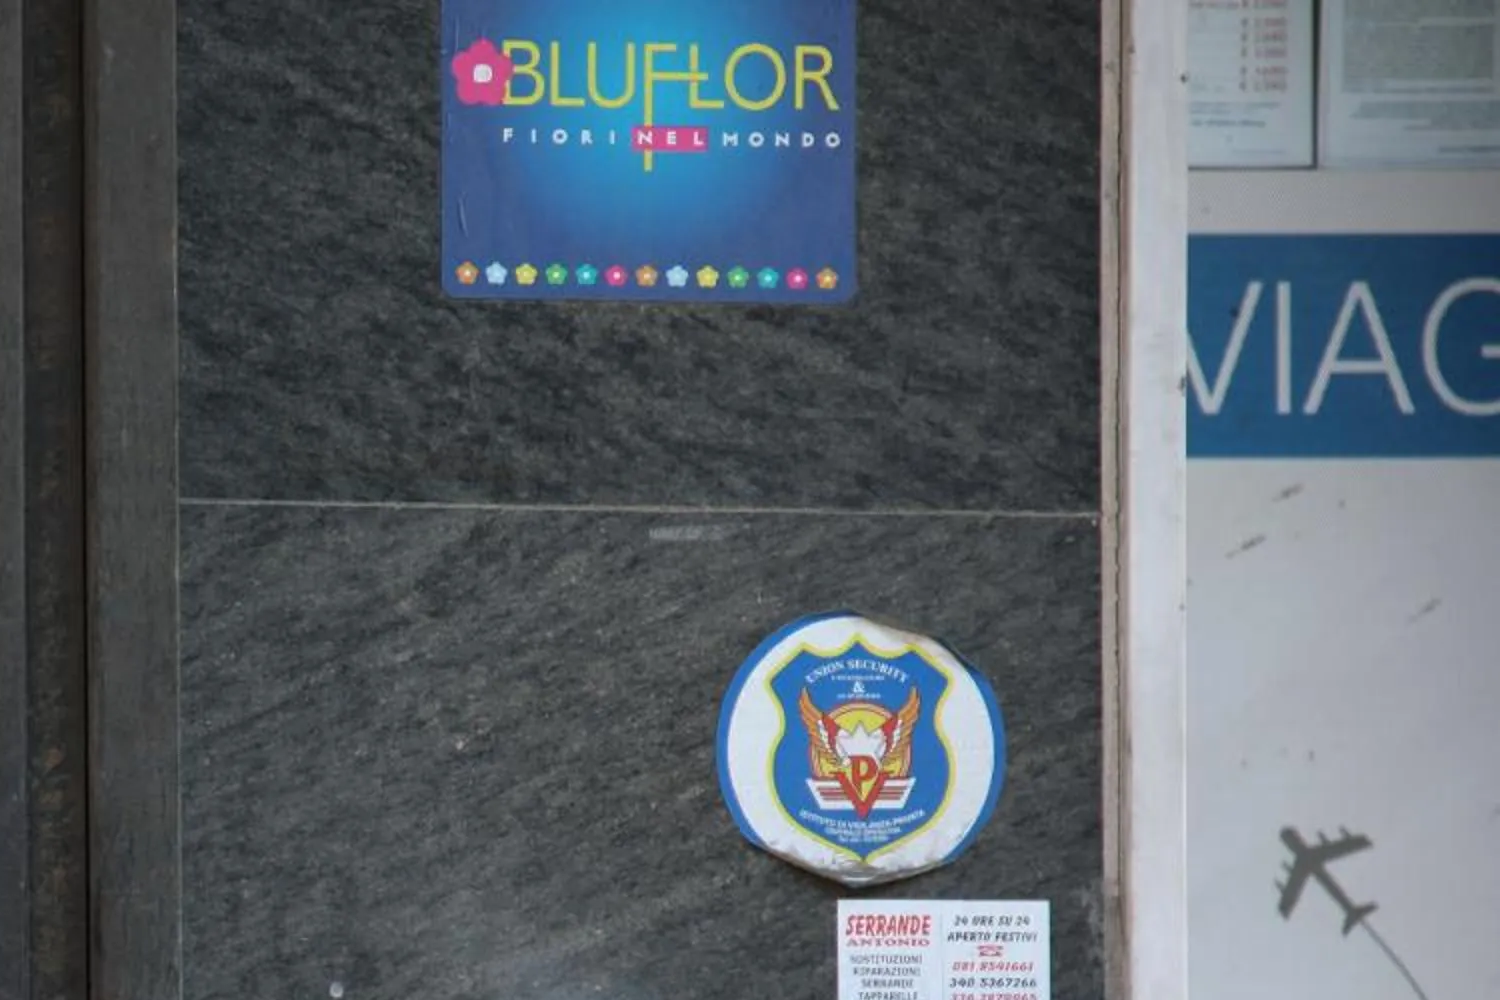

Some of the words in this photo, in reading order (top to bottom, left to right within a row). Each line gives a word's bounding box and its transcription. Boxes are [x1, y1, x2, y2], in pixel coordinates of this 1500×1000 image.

[501, 39, 840, 171] BLUFLOR
[503, 128, 616, 145] FIORI
[637, 131, 704, 146] NEL
[722, 132, 841, 147] MONDO
[1186, 277, 1500, 416] VIAG
[805, 660, 845, 684] UNION
[847, 659, 909, 684] SECURITY
[845, 914, 931, 936] SERRANDE
[971, 915, 994, 926] ORE
[846, 938, 931, 948] ANTONIO
[947, 931, 990, 942] APERTO
[994, 931, 1037, 942] FESTIVI
[850, 954, 922, 964] SOSTITUZIONI
